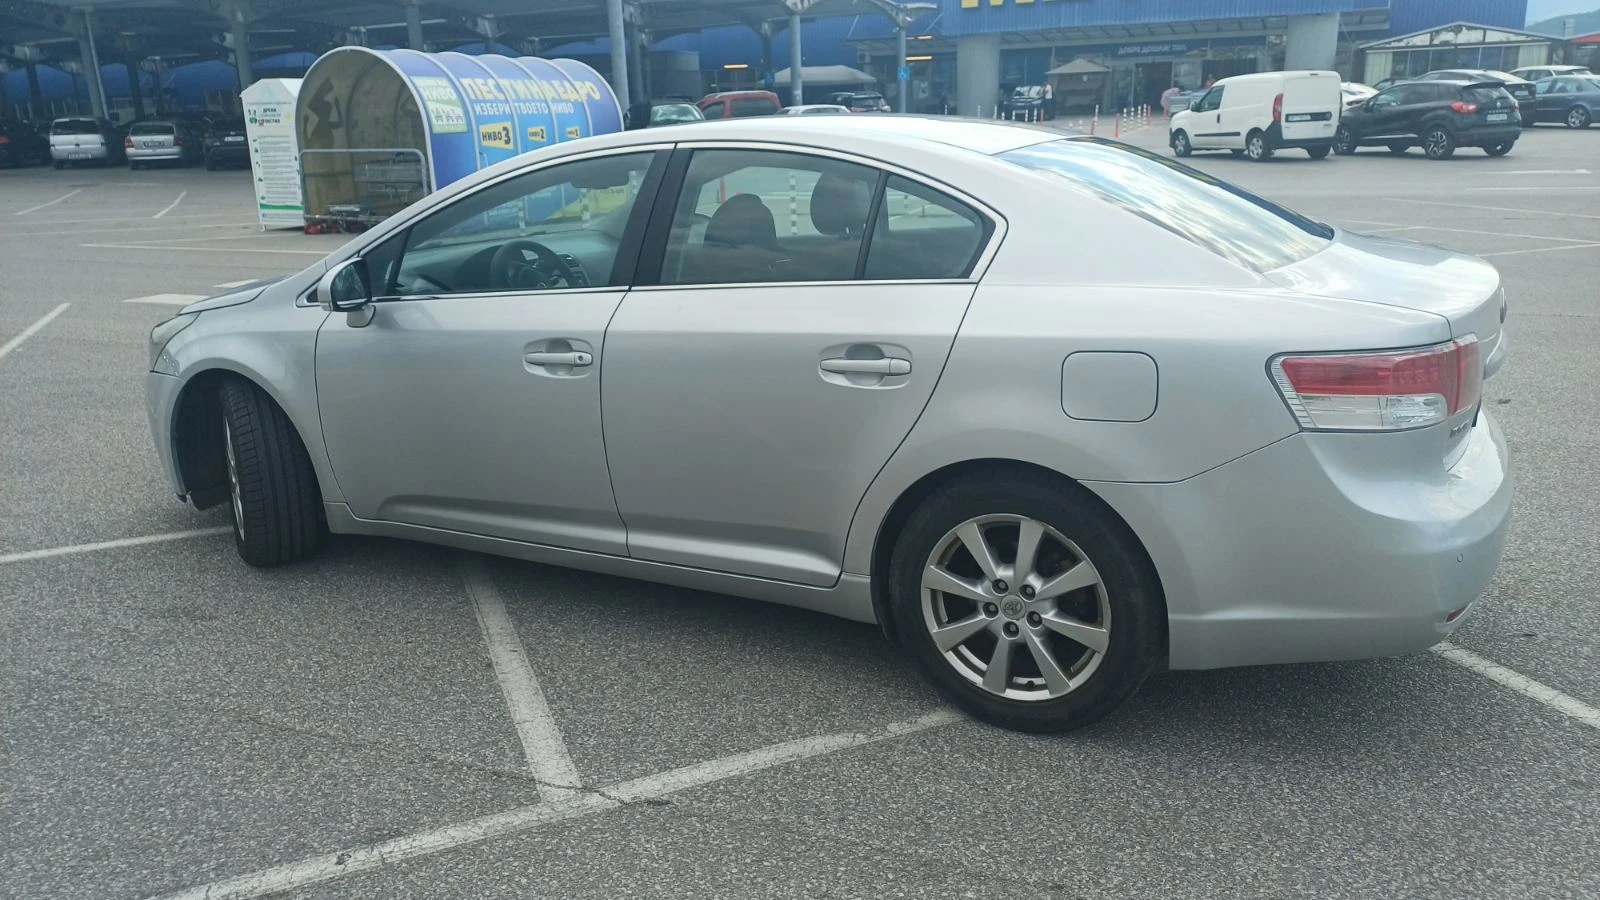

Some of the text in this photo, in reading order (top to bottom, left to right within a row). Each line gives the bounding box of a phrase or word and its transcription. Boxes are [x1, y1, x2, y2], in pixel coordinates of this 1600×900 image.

[473, 102, 511, 116] ИЗБЕРИ
[514, 103, 549, 115] ТВОЕТО
[481, 126, 511, 145] НИВО 3
[539, 128, 545, 140] 2
